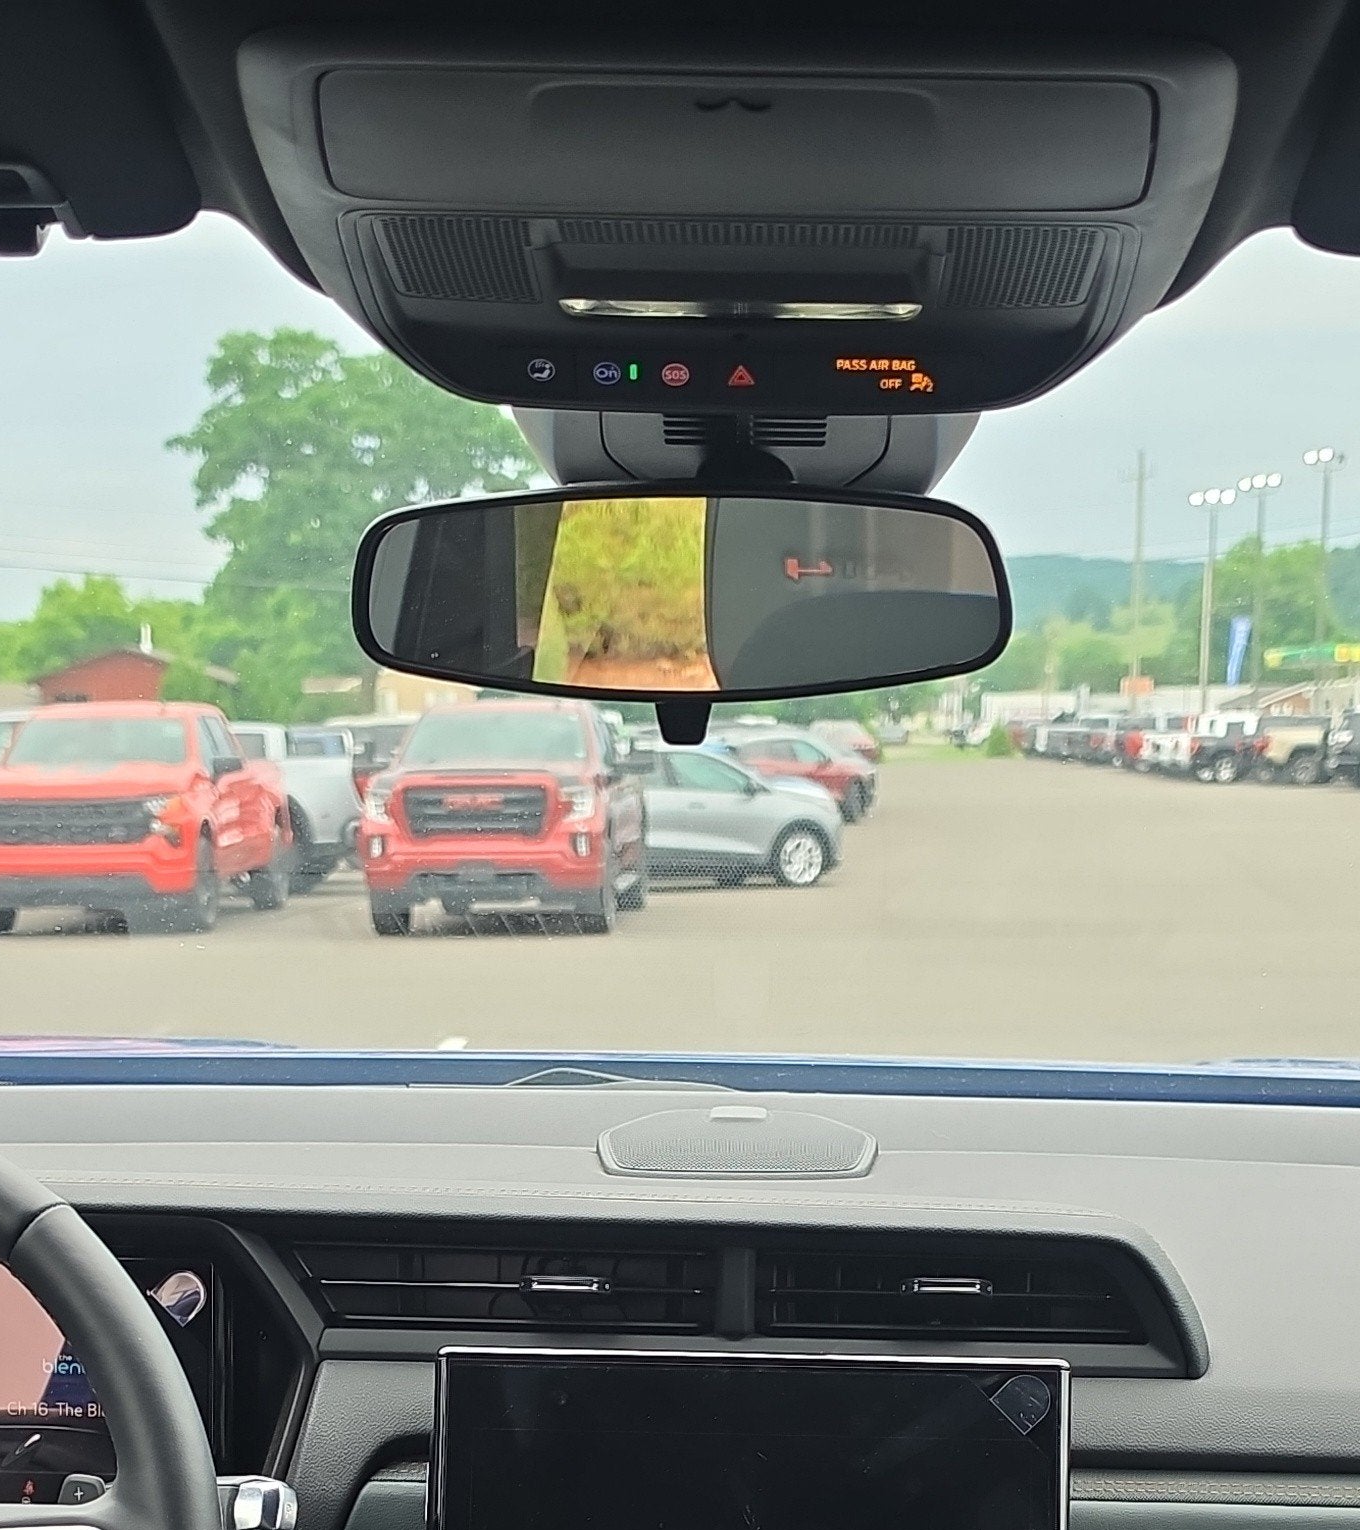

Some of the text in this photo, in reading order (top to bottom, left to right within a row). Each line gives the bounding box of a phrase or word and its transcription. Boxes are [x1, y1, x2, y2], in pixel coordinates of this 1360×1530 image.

[836, 359, 916, 372] PASS AIR BAG
[664, 368, 687, 381] SOS
[880, 378, 903, 390] OFF
[7, 1402, 27, 1417] Ch
[31, 1402, 48, 1417] 16
[55, 1403, 83, 1418] The
